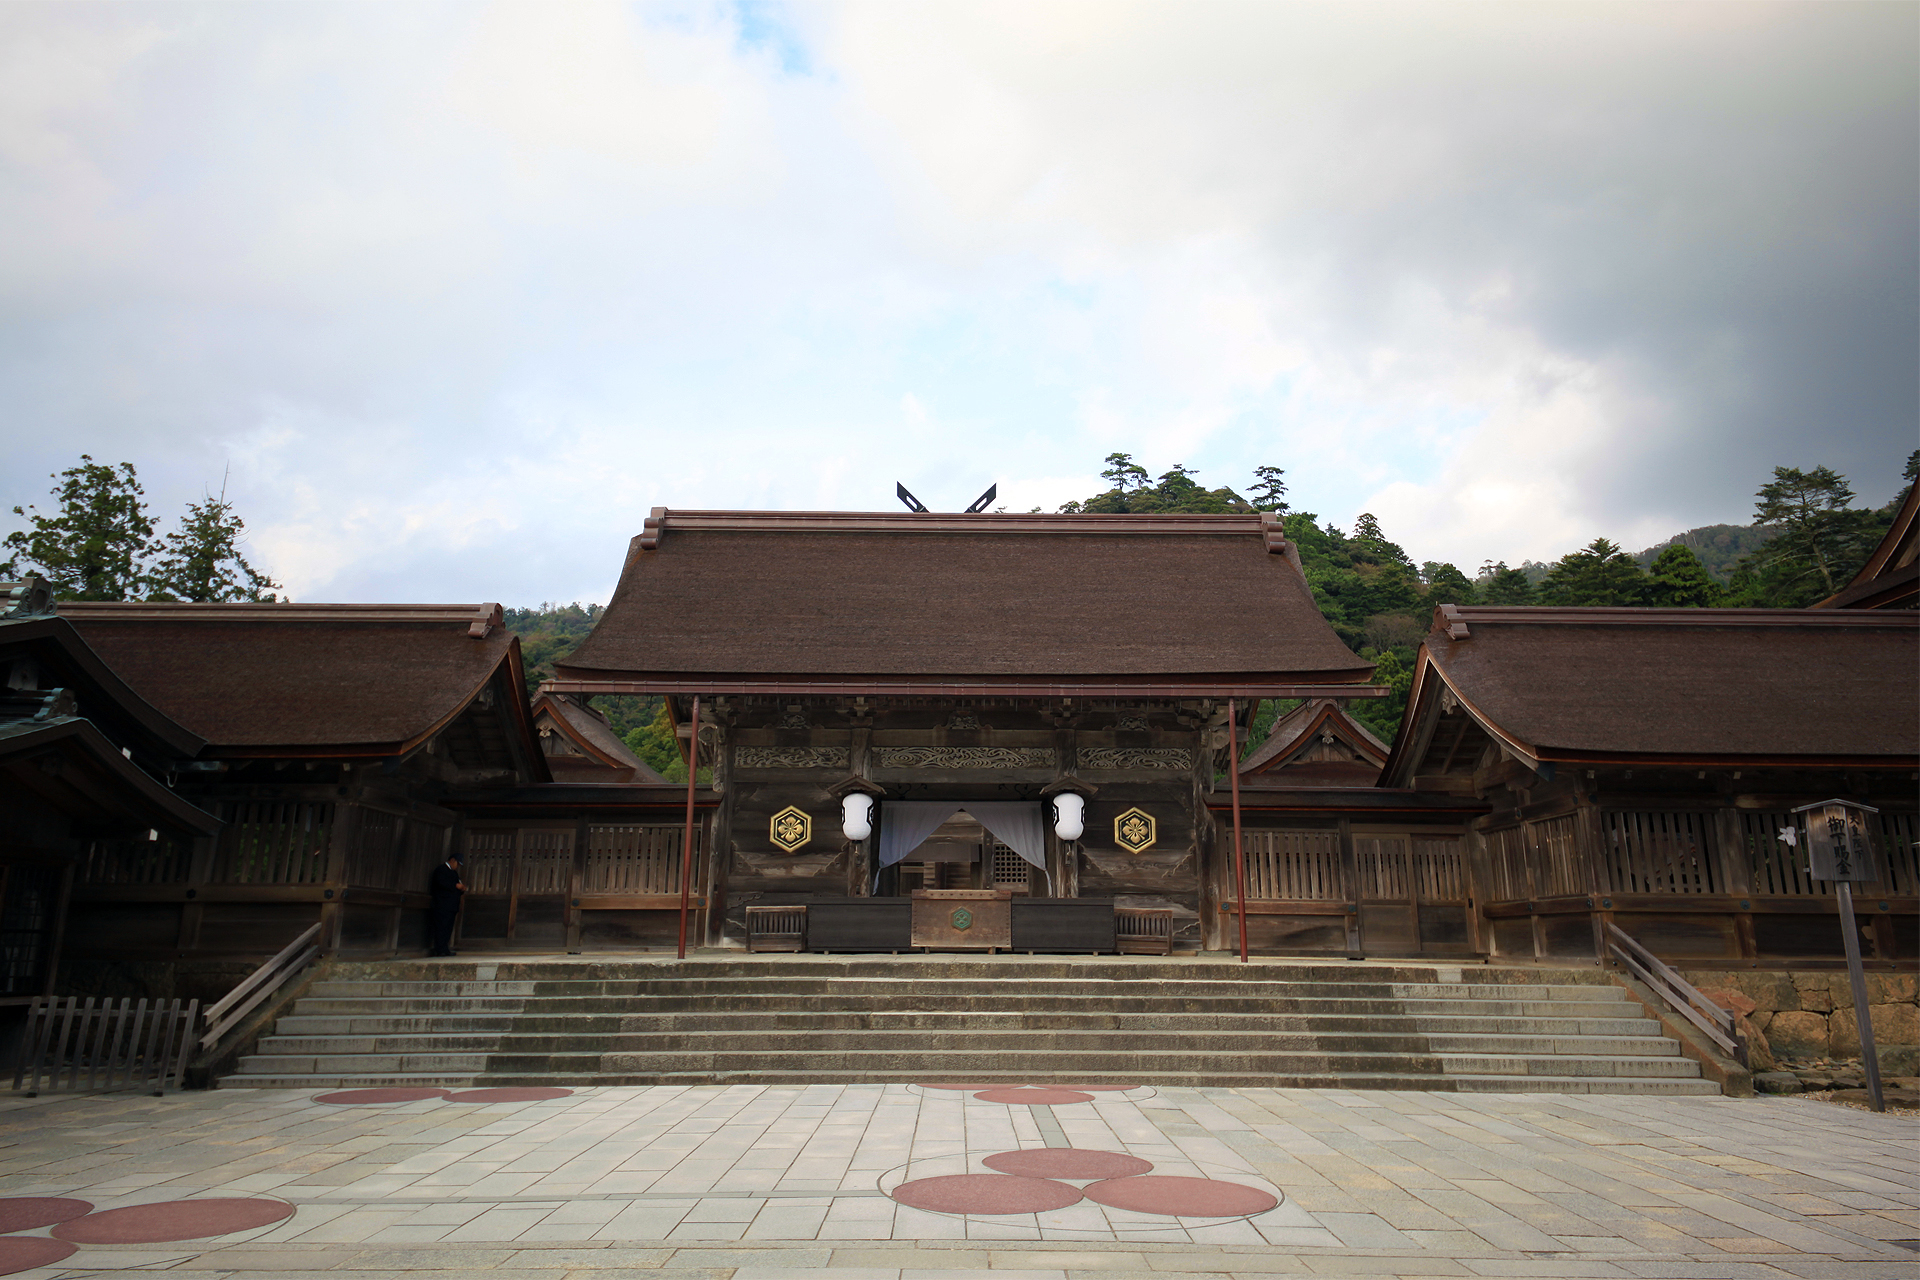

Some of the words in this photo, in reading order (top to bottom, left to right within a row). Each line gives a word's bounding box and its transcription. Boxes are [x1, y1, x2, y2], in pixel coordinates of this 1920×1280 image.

[1827, 816, 1852, 875] 御下賜金
[1849, 814, 1864, 860] 天皇陛下
